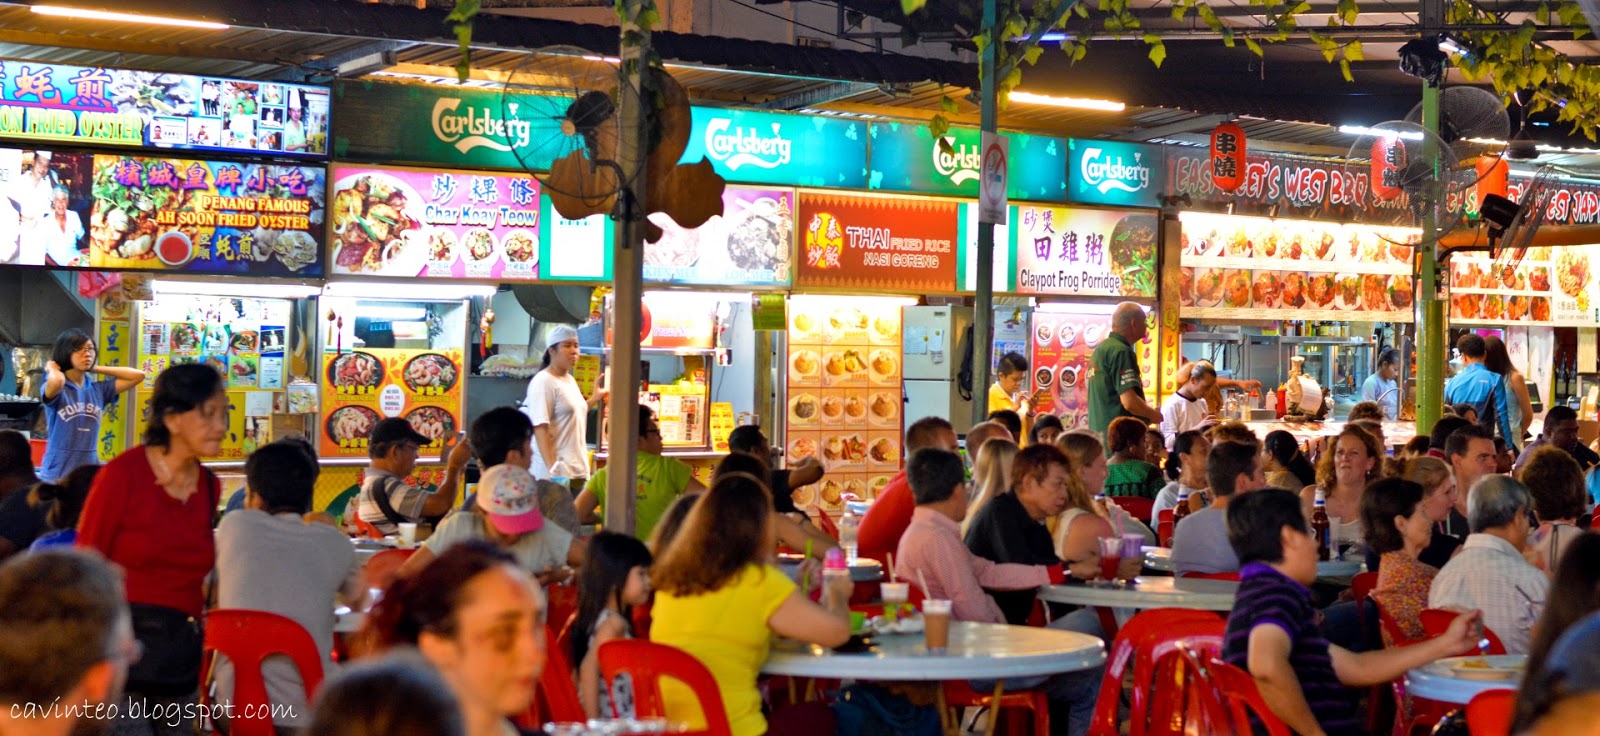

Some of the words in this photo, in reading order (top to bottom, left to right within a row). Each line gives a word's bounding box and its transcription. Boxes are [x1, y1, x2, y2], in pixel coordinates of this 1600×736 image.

[26, 107, 77, 136] FRIED
[79, 110, 142, 140] OYSTER
[432, 97, 531, 147] Carlsberg
[705, 117, 791, 164] Carlsberg
[933, 136, 981, 177] Carlsb
[1213, 133, 1237, 178] 串燒
[1081, 147, 1149, 188] Carlsberg
[203, 195, 256, 211] PENANG
[258, 198, 310, 213] FAMOUS
[432, 174, 536, 205] 炒粿條
[1284, 166, 1328, 203] WEST
[1330, 170, 1368, 212] BBQ
[157, 211, 176, 225] AH
[178, 211, 216, 227] SOON
[218, 213, 257, 228] FRIED
[259, 215, 310, 230] OYSTER
[426, 204, 458, 225] Char
[461, 206, 497, 229] Koay
[500, 207, 537, 227] Teow
[1023, 209, 1055, 234] 砂煲
[1572, 190, 1600, 224] JAP
[846, 225, 890, 250] THAI
[890, 237, 922, 251] FRIED
[924, 240, 951, 253] RICE
[1034, 231, 1104, 266] 田雞粥
[863, 252, 890, 266] NASI
[891, 254, 939, 268] GORENG
[1020, 269, 1056, 291] Claypot
[1058, 271, 1079, 293] Frog
[1082, 272, 1121, 292] Porridge
